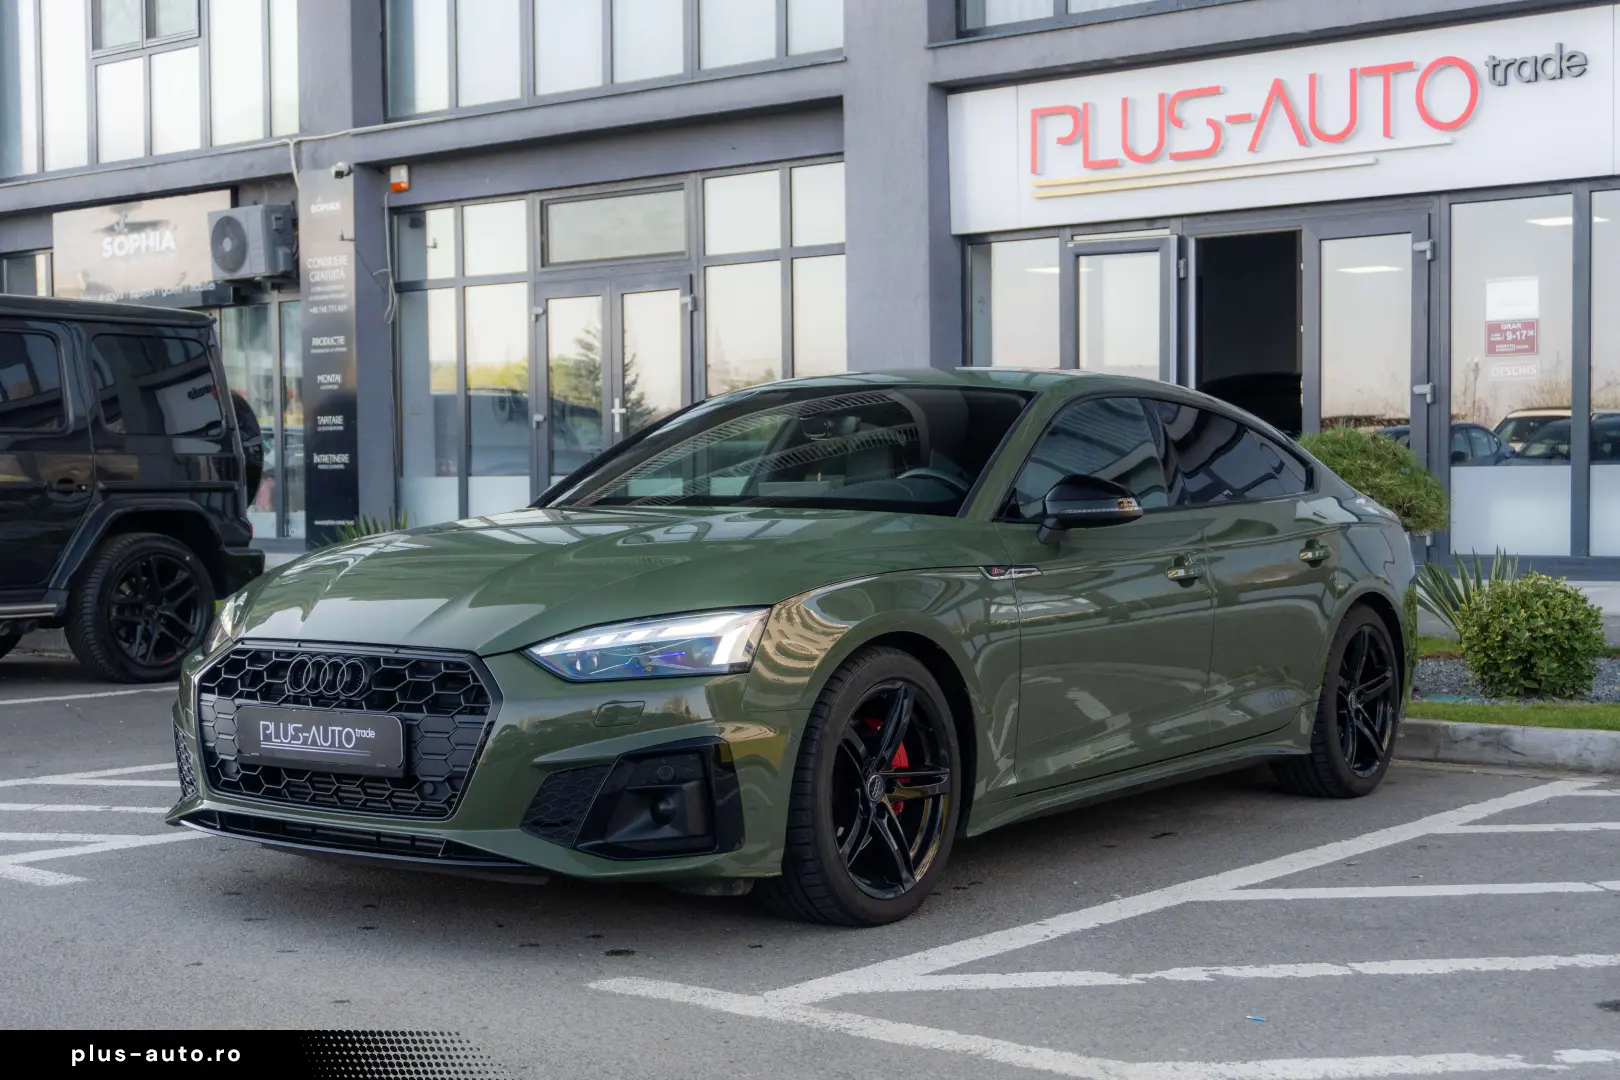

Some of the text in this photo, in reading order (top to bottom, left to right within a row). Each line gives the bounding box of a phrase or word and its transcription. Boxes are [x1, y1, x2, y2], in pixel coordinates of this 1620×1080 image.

[1030, 42, 1588, 175] PLUS-AUTO trade
[102, 229, 177, 259] SOPHIA
[1491, 364, 1537, 377] DESCHIS
[260, 720, 376, 748] PLUS-AUTO trade
